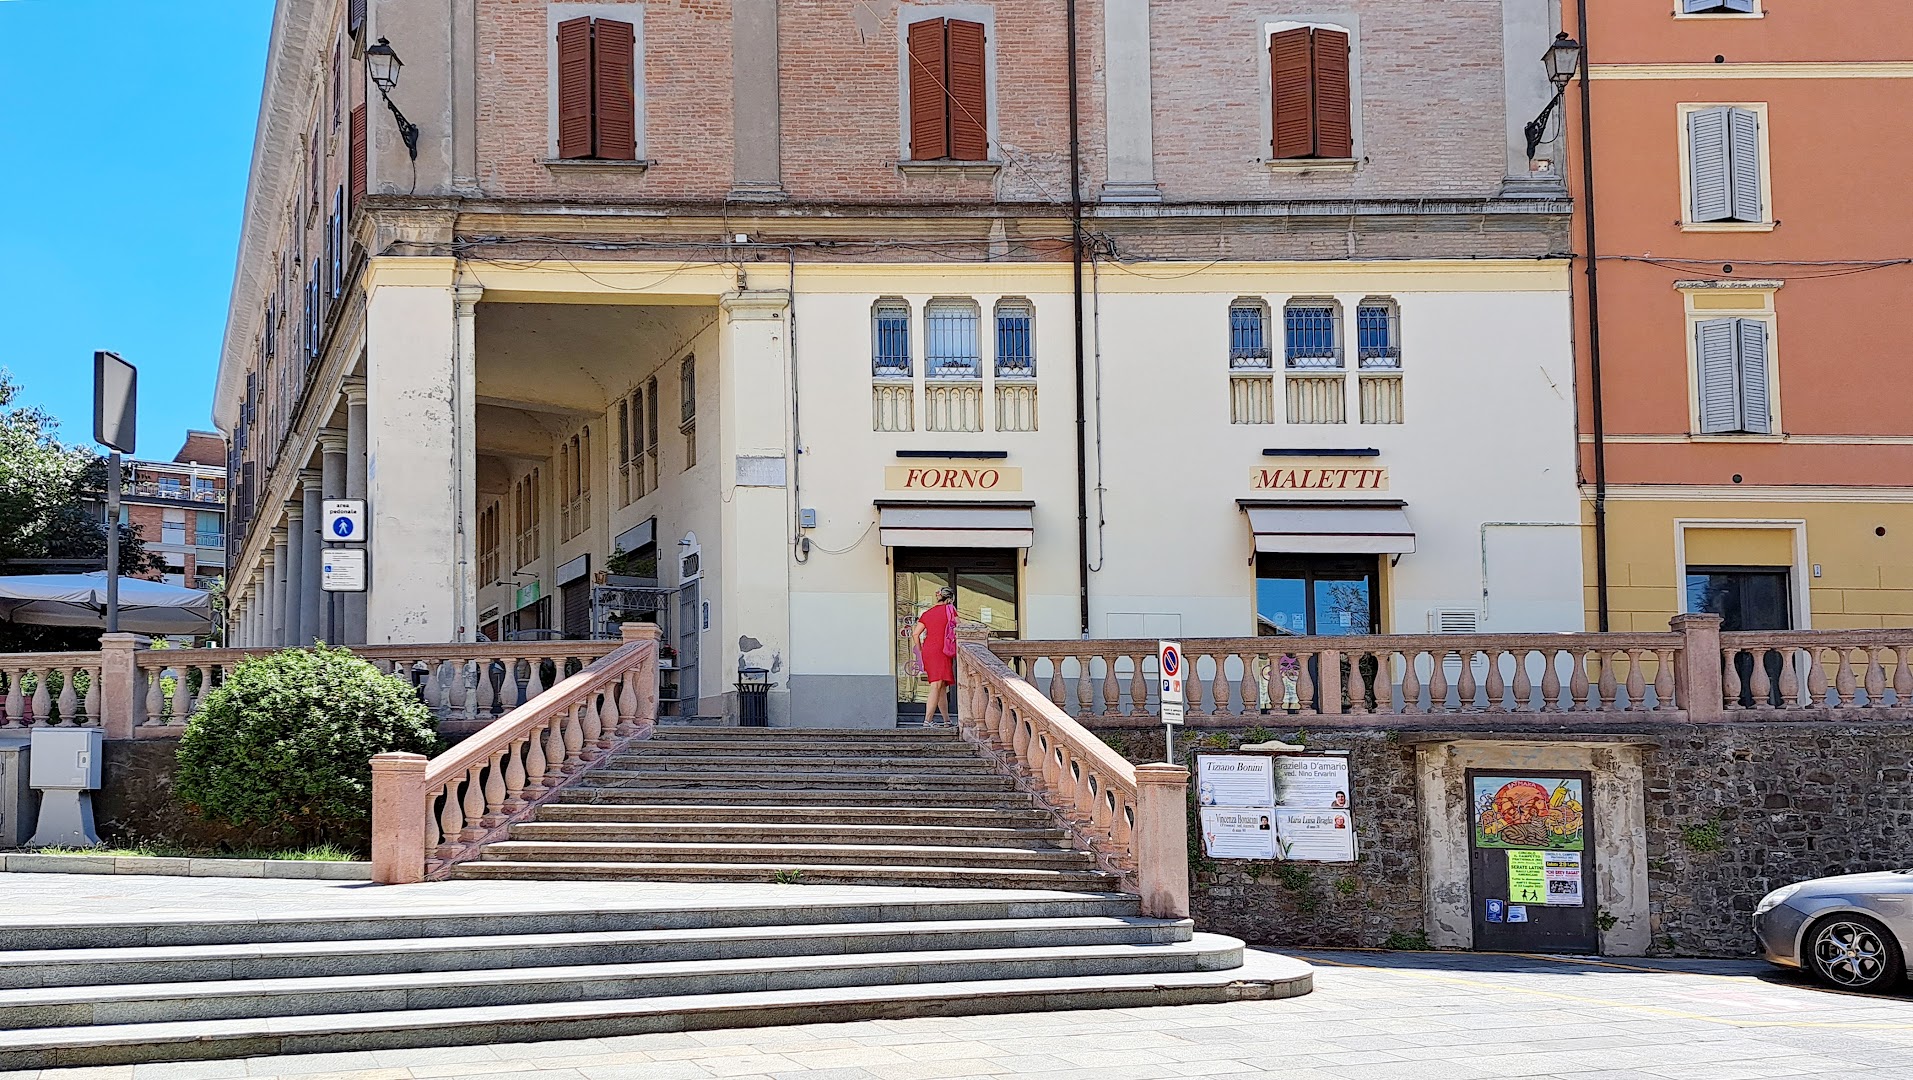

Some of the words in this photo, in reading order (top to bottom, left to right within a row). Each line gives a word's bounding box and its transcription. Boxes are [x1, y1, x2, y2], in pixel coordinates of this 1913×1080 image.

[904, 469, 999, 488] FORNO
[1255, 470, 1384, 488] MALETTI
[1207, 762, 1235, 771] Tiziano
[1236, 762, 1264, 772] Bonini
[1276, 762, 1308, 770] raziella
[1310, 762, 1346, 770] D'amario
[1216, 814, 1236, 824] Vincenza
